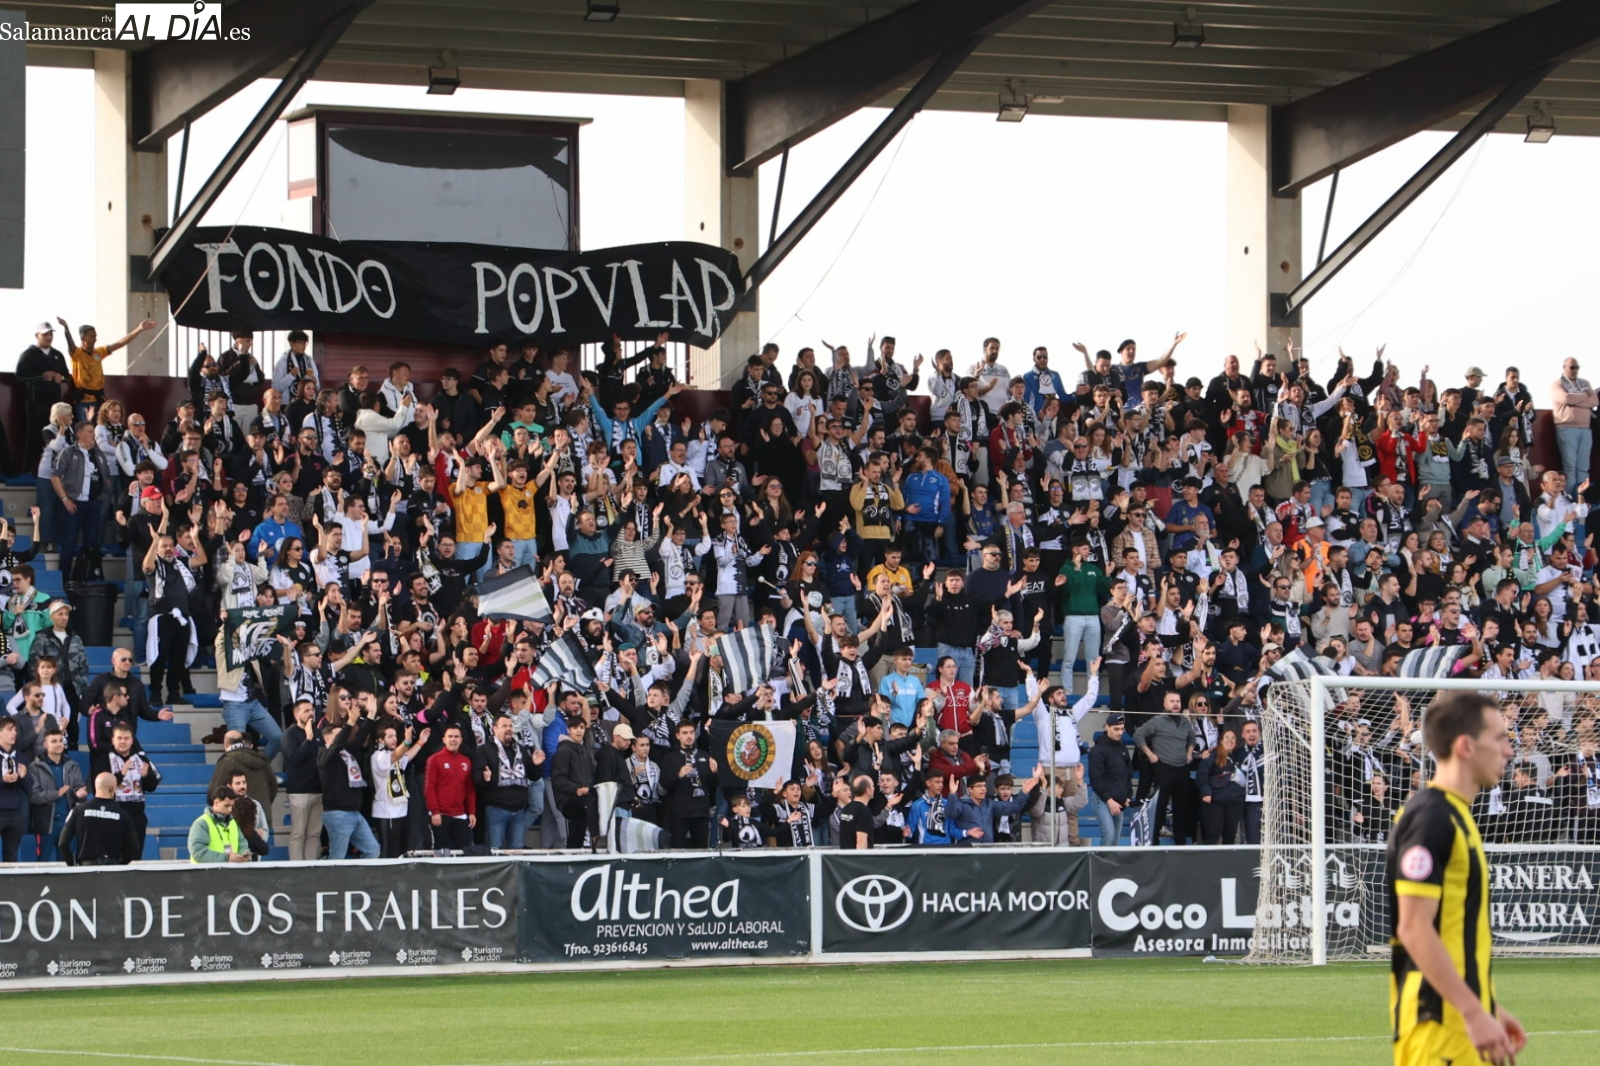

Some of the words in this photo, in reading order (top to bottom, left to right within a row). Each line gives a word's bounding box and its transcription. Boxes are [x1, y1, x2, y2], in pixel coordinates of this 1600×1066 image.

[194, 239, 396, 321] FONDO
[84, 809, 120, 821] SEGURIDAD
[923, 891, 1003, 914] HACHA
[1009, 890, 1090, 913] MOTOR
[124, 895, 185, 939] DE
[207, 892, 293, 936] LOS
[316, 887, 507, 933] FRAILES
[597, 923, 674, 938] PREVENCION
[678, 922, 687, 937] Y
[729, 920, 785, 935] LABORAL
[564, 942, 591, 956] Tfno.
[593, 941, 648, 956] 923616845
[691, 938, 768, 951] www.althea.es
[1133, 934, 1204, 953] Asesora
[341, 950, 371, 958] turismo
[408, 948, 437, 956] turismo
[474, 946, 503, 954] turismo
[203, 954, 233, 963] turismo
[273, 952, 304, 960] turismo
[408, 955, 436, 964] Sardón
[473, 953, 501, 962] Sardón
[60, 960, 91, 968] turismo
[137, 957, 167, 965] turismo
[273, 959, 302, 968] Sardón
[341, 957, 369, 966] Sardón
[137, 964, 165, 973] Sardón
[203, 962, 231, 971] Sardón
[60, 967, 89, 976] Sardón
